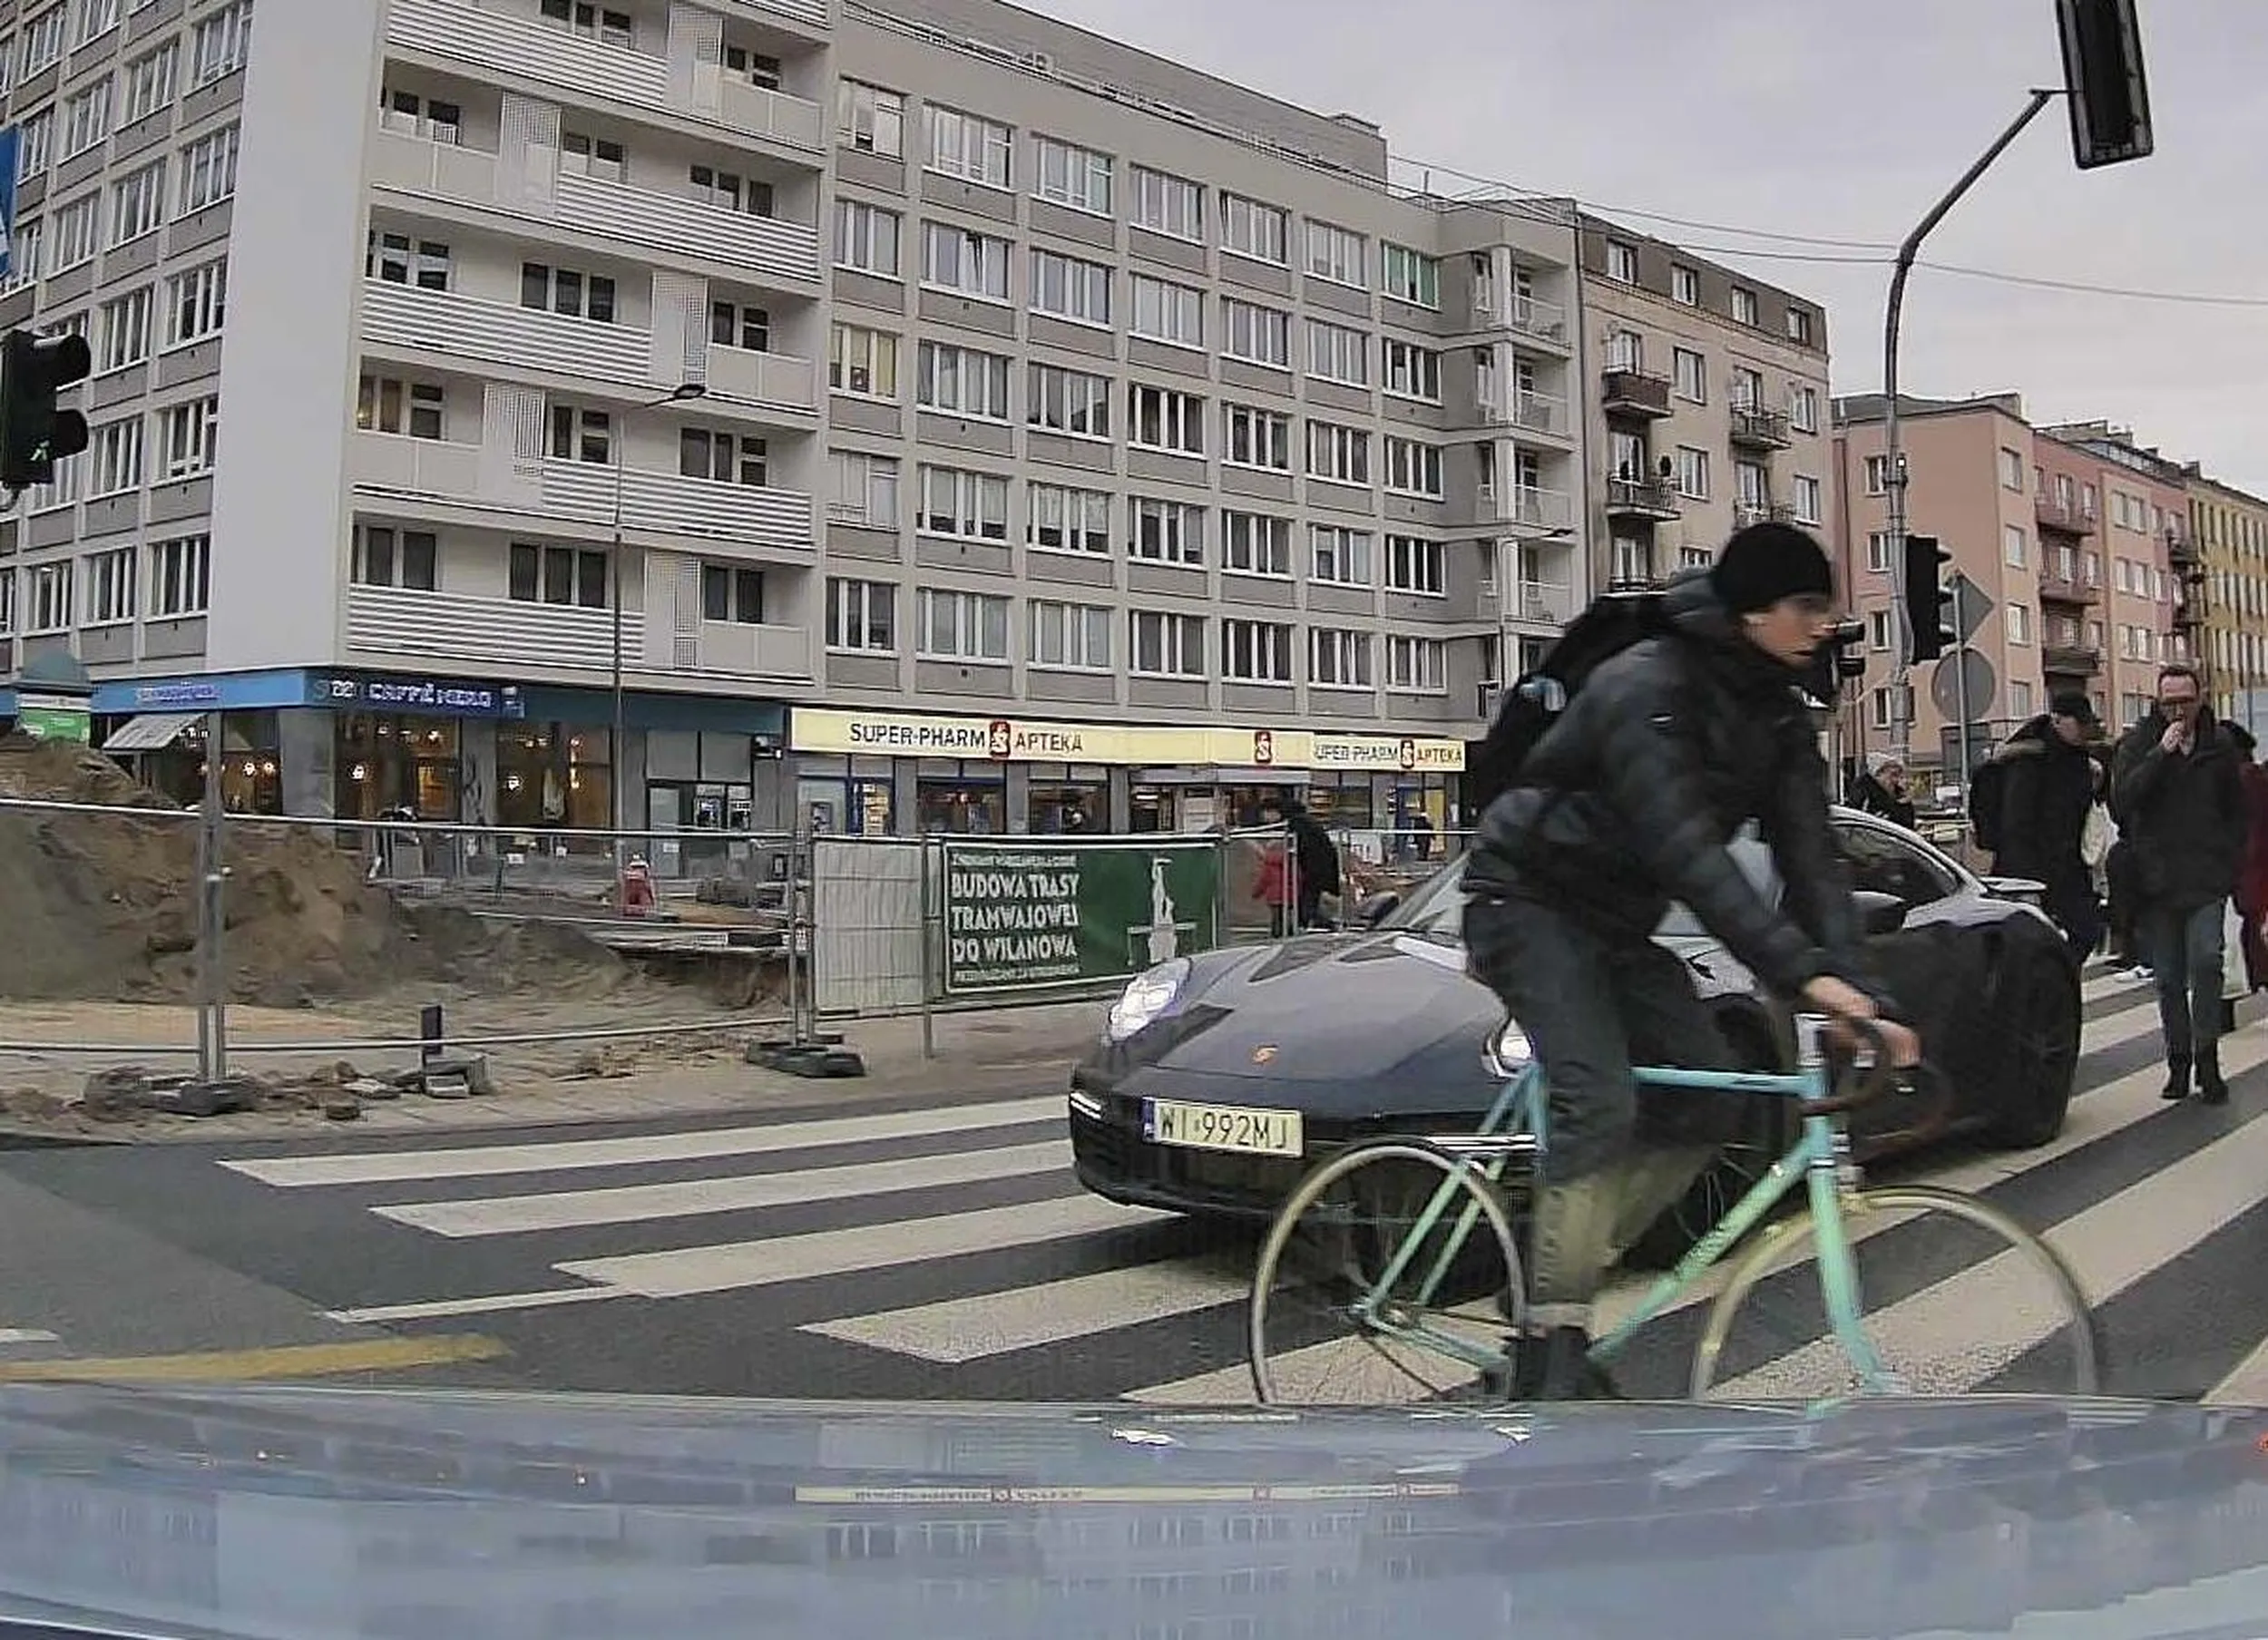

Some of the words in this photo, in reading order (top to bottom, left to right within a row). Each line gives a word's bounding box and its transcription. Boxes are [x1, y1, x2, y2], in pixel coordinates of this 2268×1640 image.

[850, 723, 984, 748] SUPER-PHARM
[1016, 731, 1083, 753] APTEKA
[952, 873, 1028, 898] BUDOWA
[1029, 873, 1080, 898] TRASY
[952, 903, 1080, 931] TRAMWAJOWEJ
[952, 938, 979, 966] DO
[982, 934, 1079, 962] WILANOWA
[1202, 1111, 1288, 1149] 992MJ
